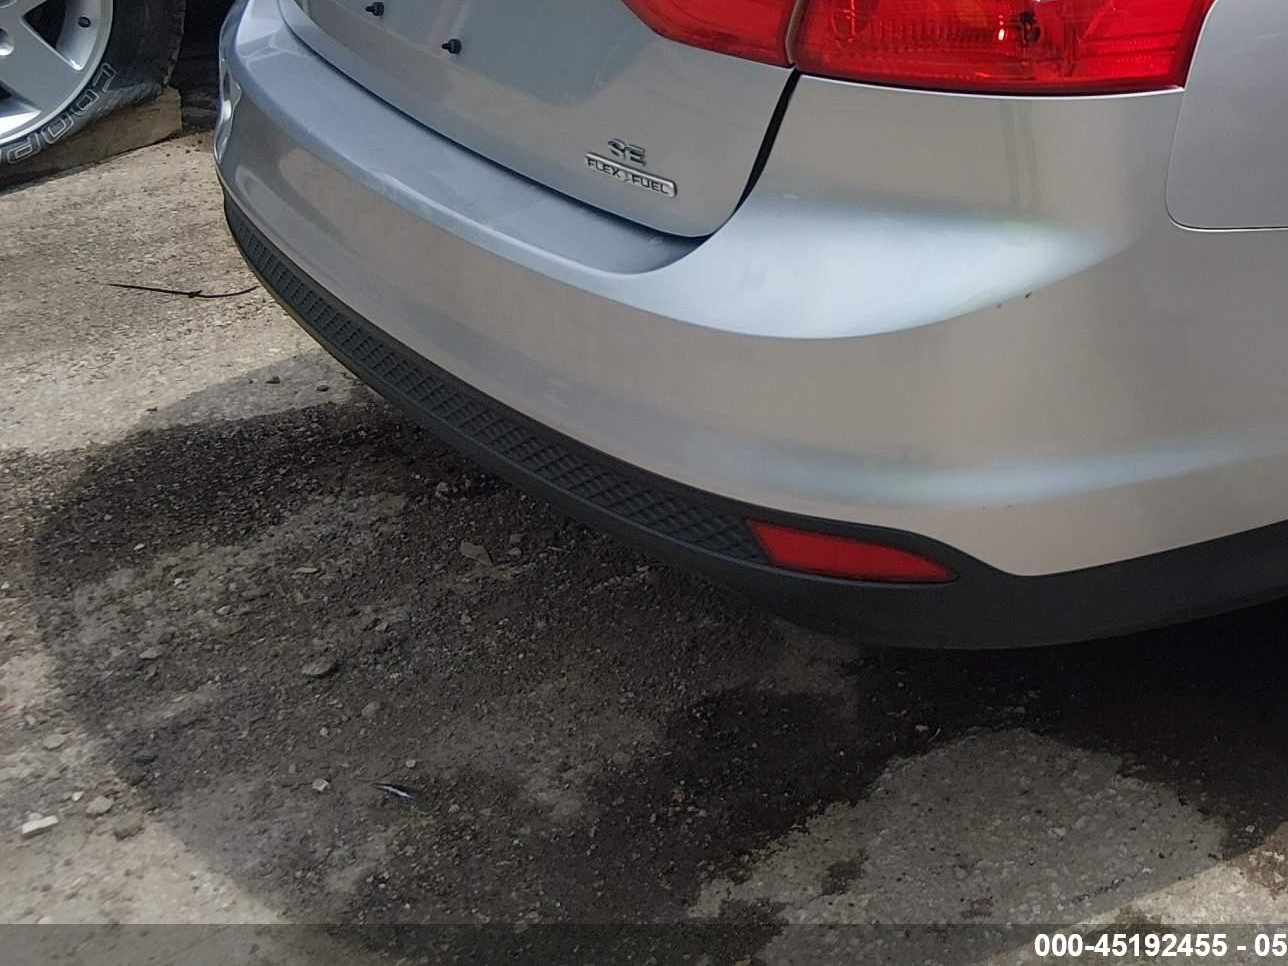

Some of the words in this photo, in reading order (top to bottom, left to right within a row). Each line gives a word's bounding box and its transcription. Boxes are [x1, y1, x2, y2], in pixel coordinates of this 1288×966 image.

[0, 62, 118, 165] COOP
[607, 138, 647, 167] SE
[586, 157, 620, 178] FLEX
[631, 174, 671, 195] FUEL
